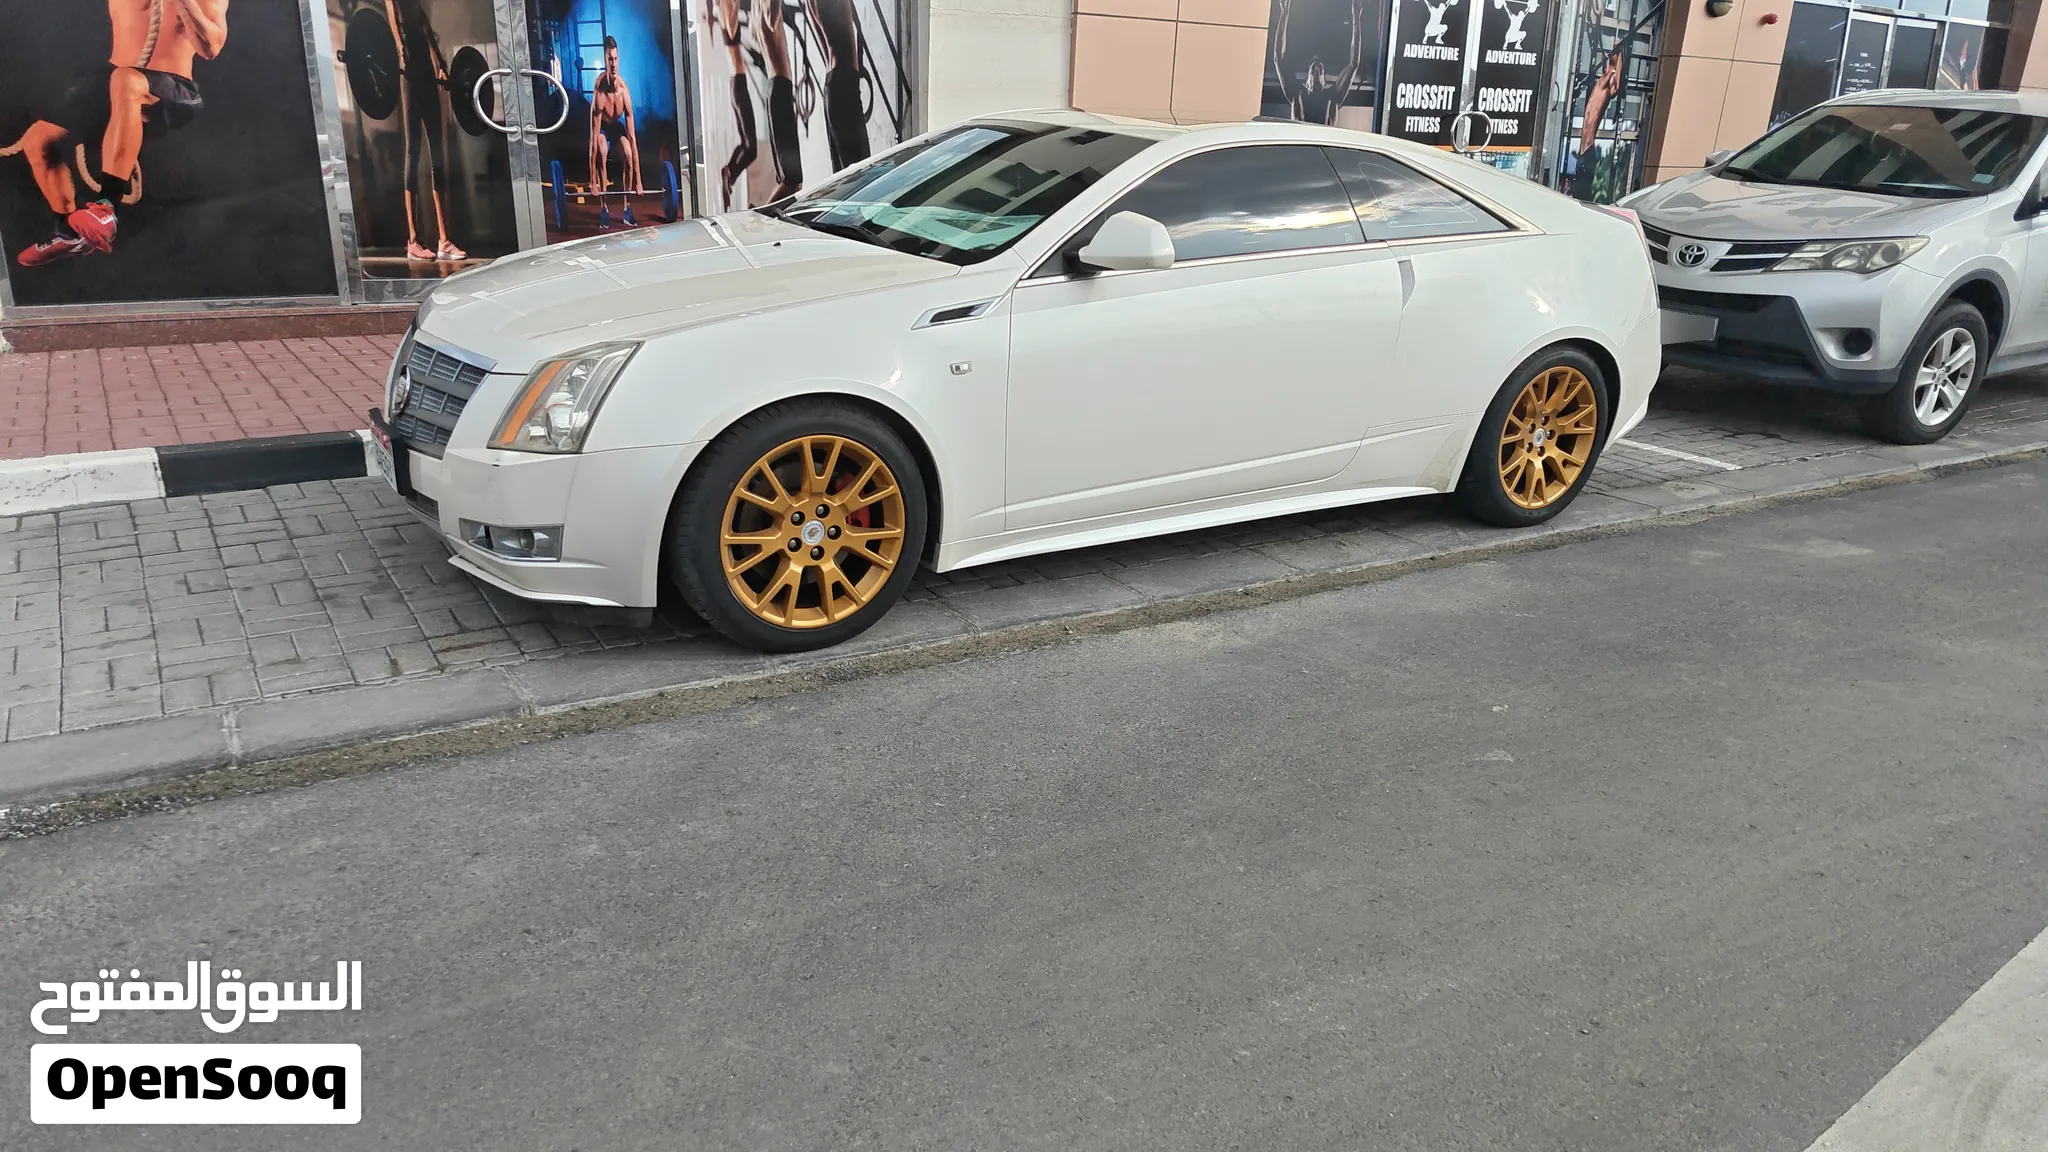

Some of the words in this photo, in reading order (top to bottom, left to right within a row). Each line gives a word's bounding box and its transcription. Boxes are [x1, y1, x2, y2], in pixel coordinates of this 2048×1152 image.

[1403, 43, 1459, 61] ADVENTURE
[1485, 49, 1537, 65] ADVENTURE
[1396, 82, 1456, 110] CROSSFIT
[1478, 87, 1533, 113] CROSSFIT
[1405, 115, 1441, 133] FITNESS
